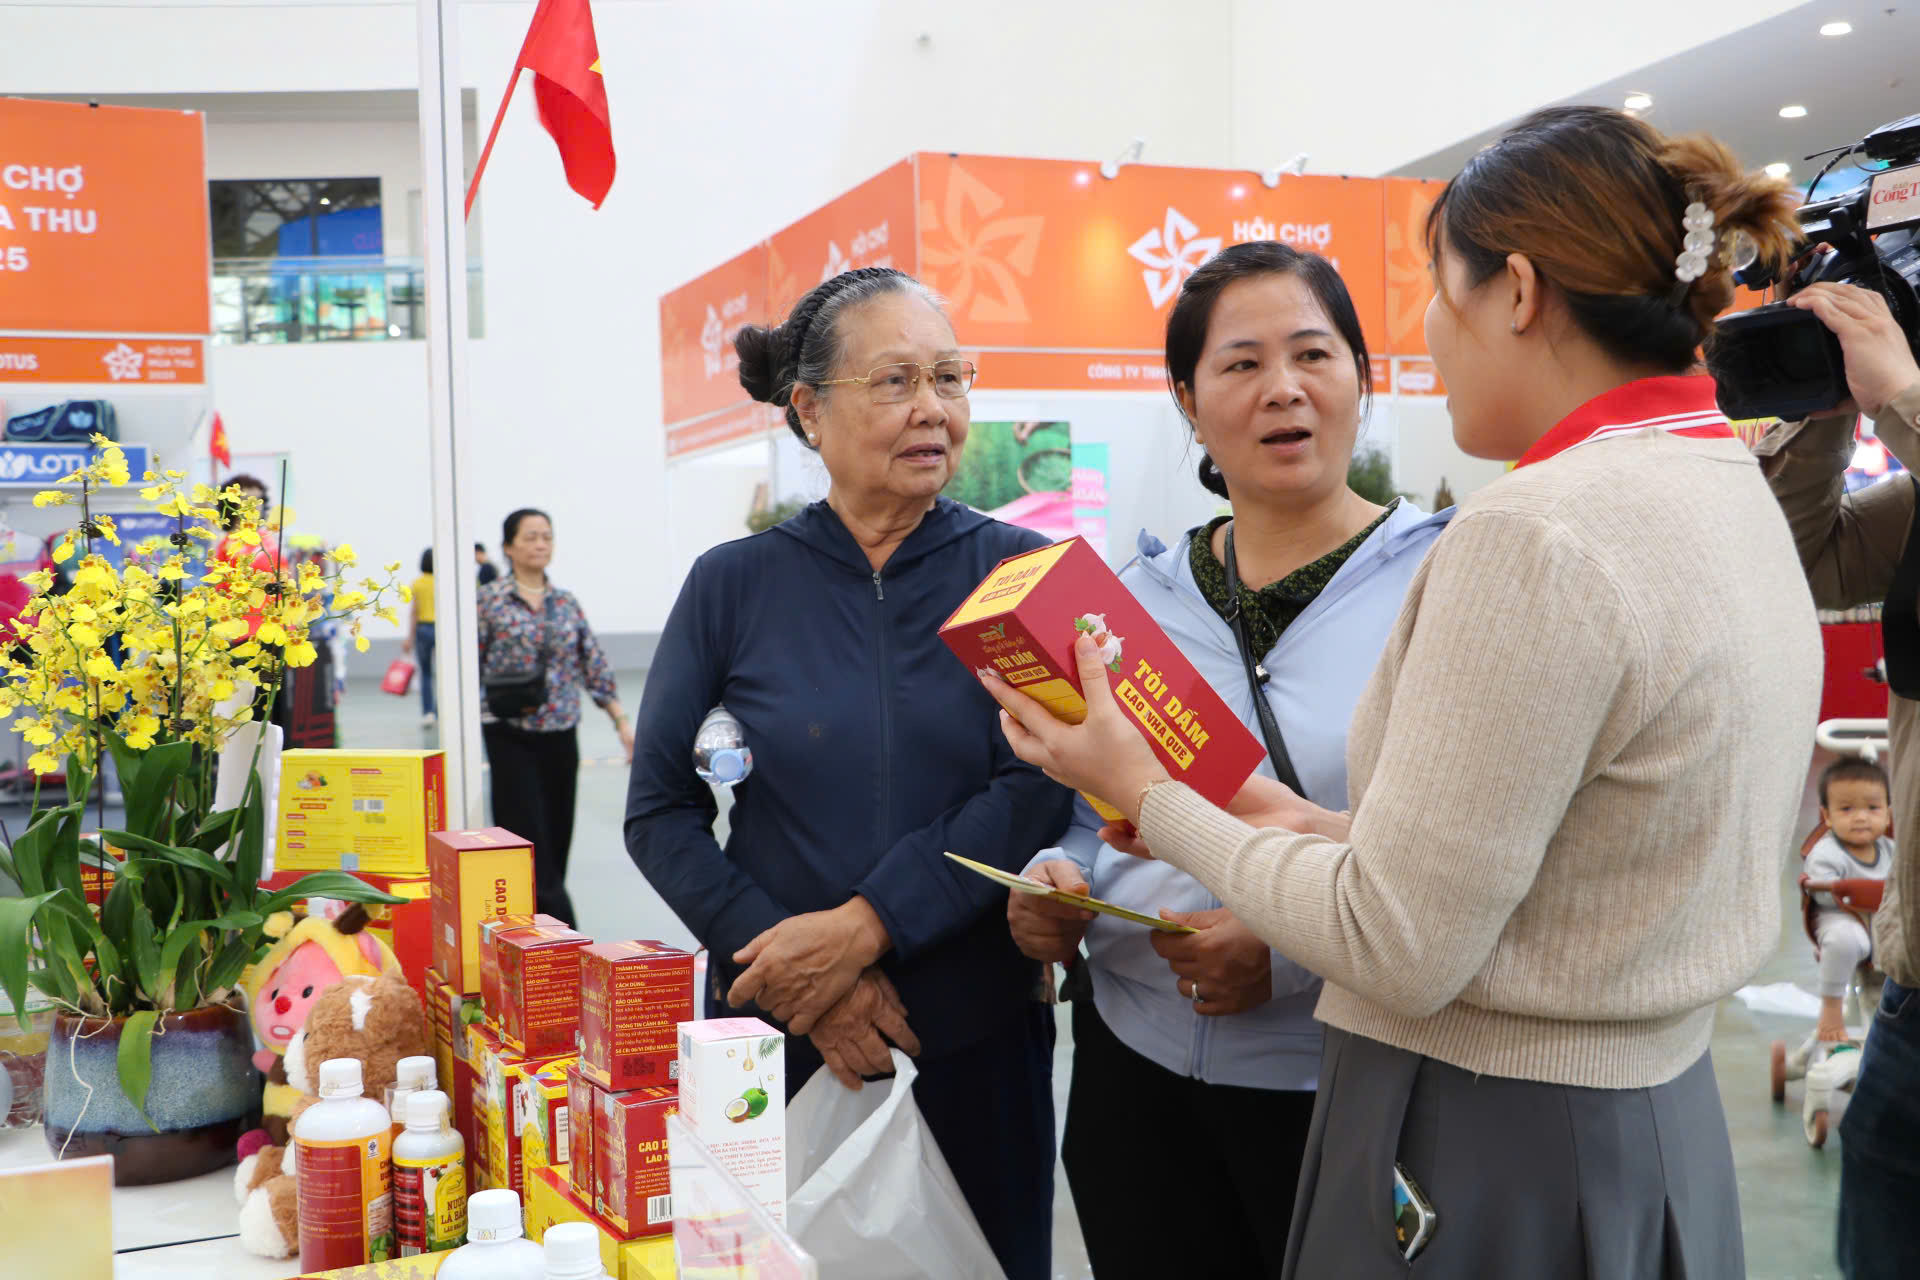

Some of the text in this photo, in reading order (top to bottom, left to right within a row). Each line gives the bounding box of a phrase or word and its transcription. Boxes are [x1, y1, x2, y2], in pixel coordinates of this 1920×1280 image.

[3, 164, 84, 200] CHỢ
[23, 207, 97, 234] THU
[1280, 222, 1332, 250] CHỢ
[0, 246, 29, 272] 5
[1134, 658, 1210, 750] TỎI DẤM
[1145, 710, 1168, 739] NHÀ
[1166, 735, 1188, 761] QUÊ
[495, 878, 507, 904] CAO
[615, 1022, 634, 1030] THÔNG
[642, 1020, 657, 1028] CẢNH
[638, 1140, 659, 1153] CAO
